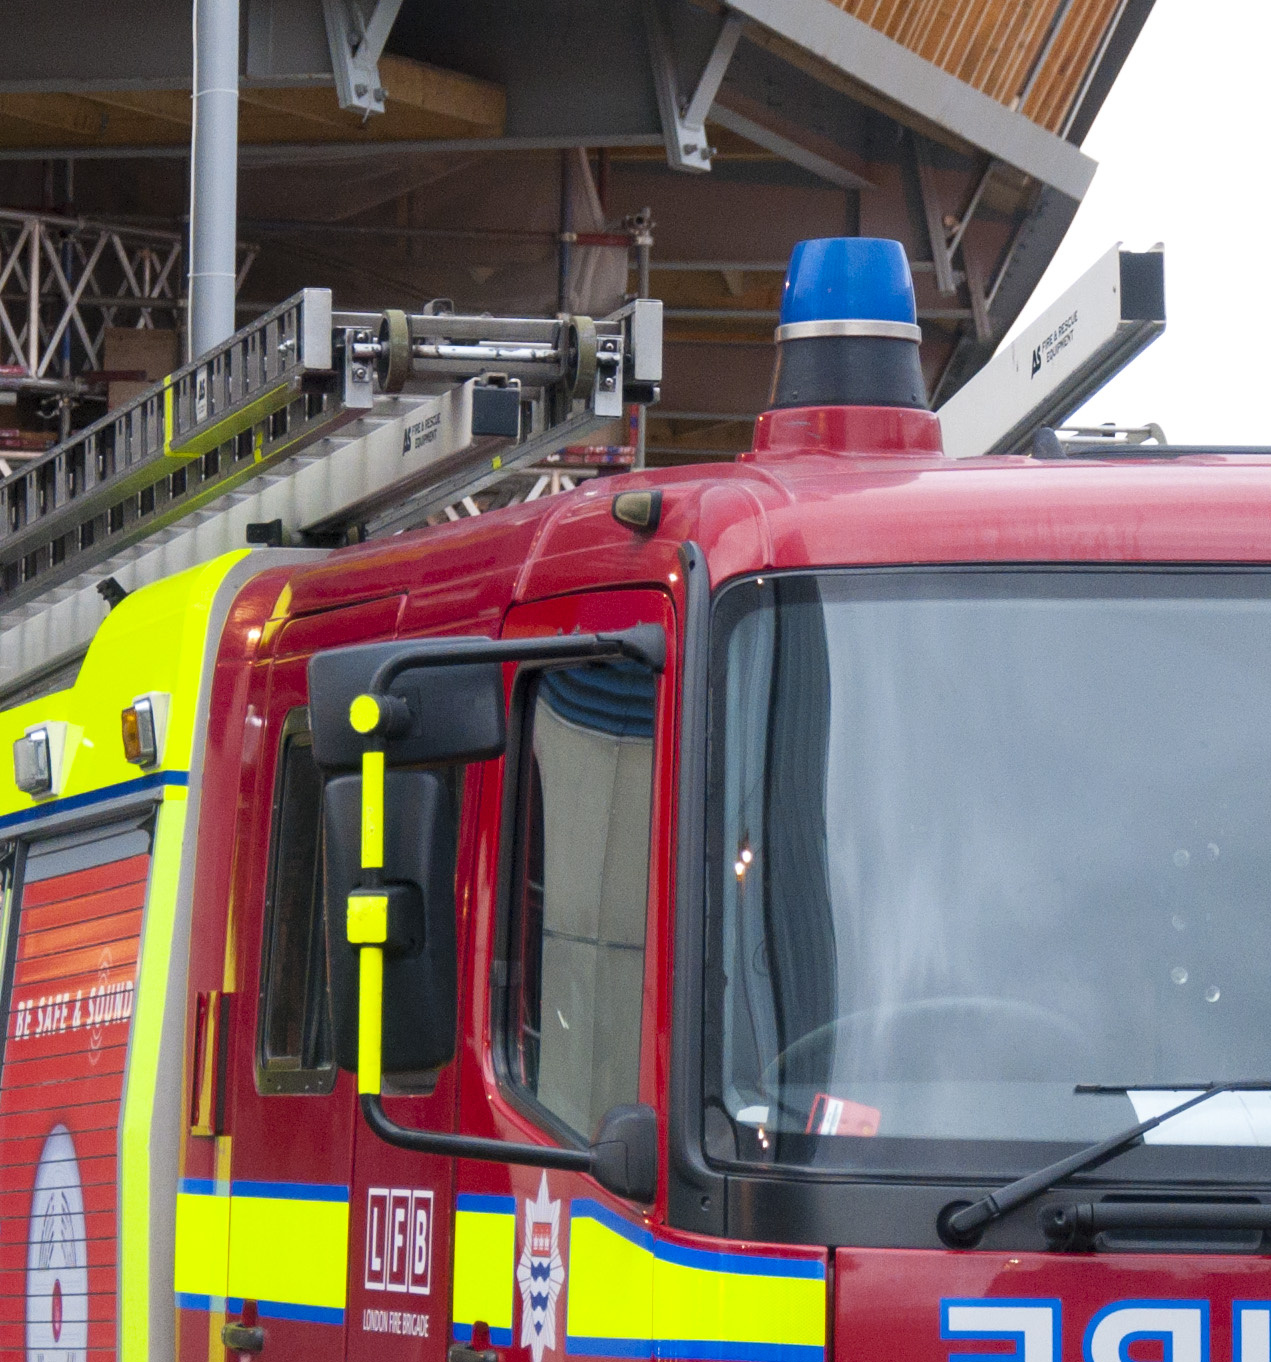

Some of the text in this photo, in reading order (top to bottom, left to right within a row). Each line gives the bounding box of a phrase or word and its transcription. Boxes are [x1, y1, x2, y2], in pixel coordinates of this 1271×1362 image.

[14, 980, 134, 1041] BE SAFE & SOUND
[370, 1205, 428, 1277] LFB
[363, 1309, 429, 1337] LONDON FIRE BRIGADE
